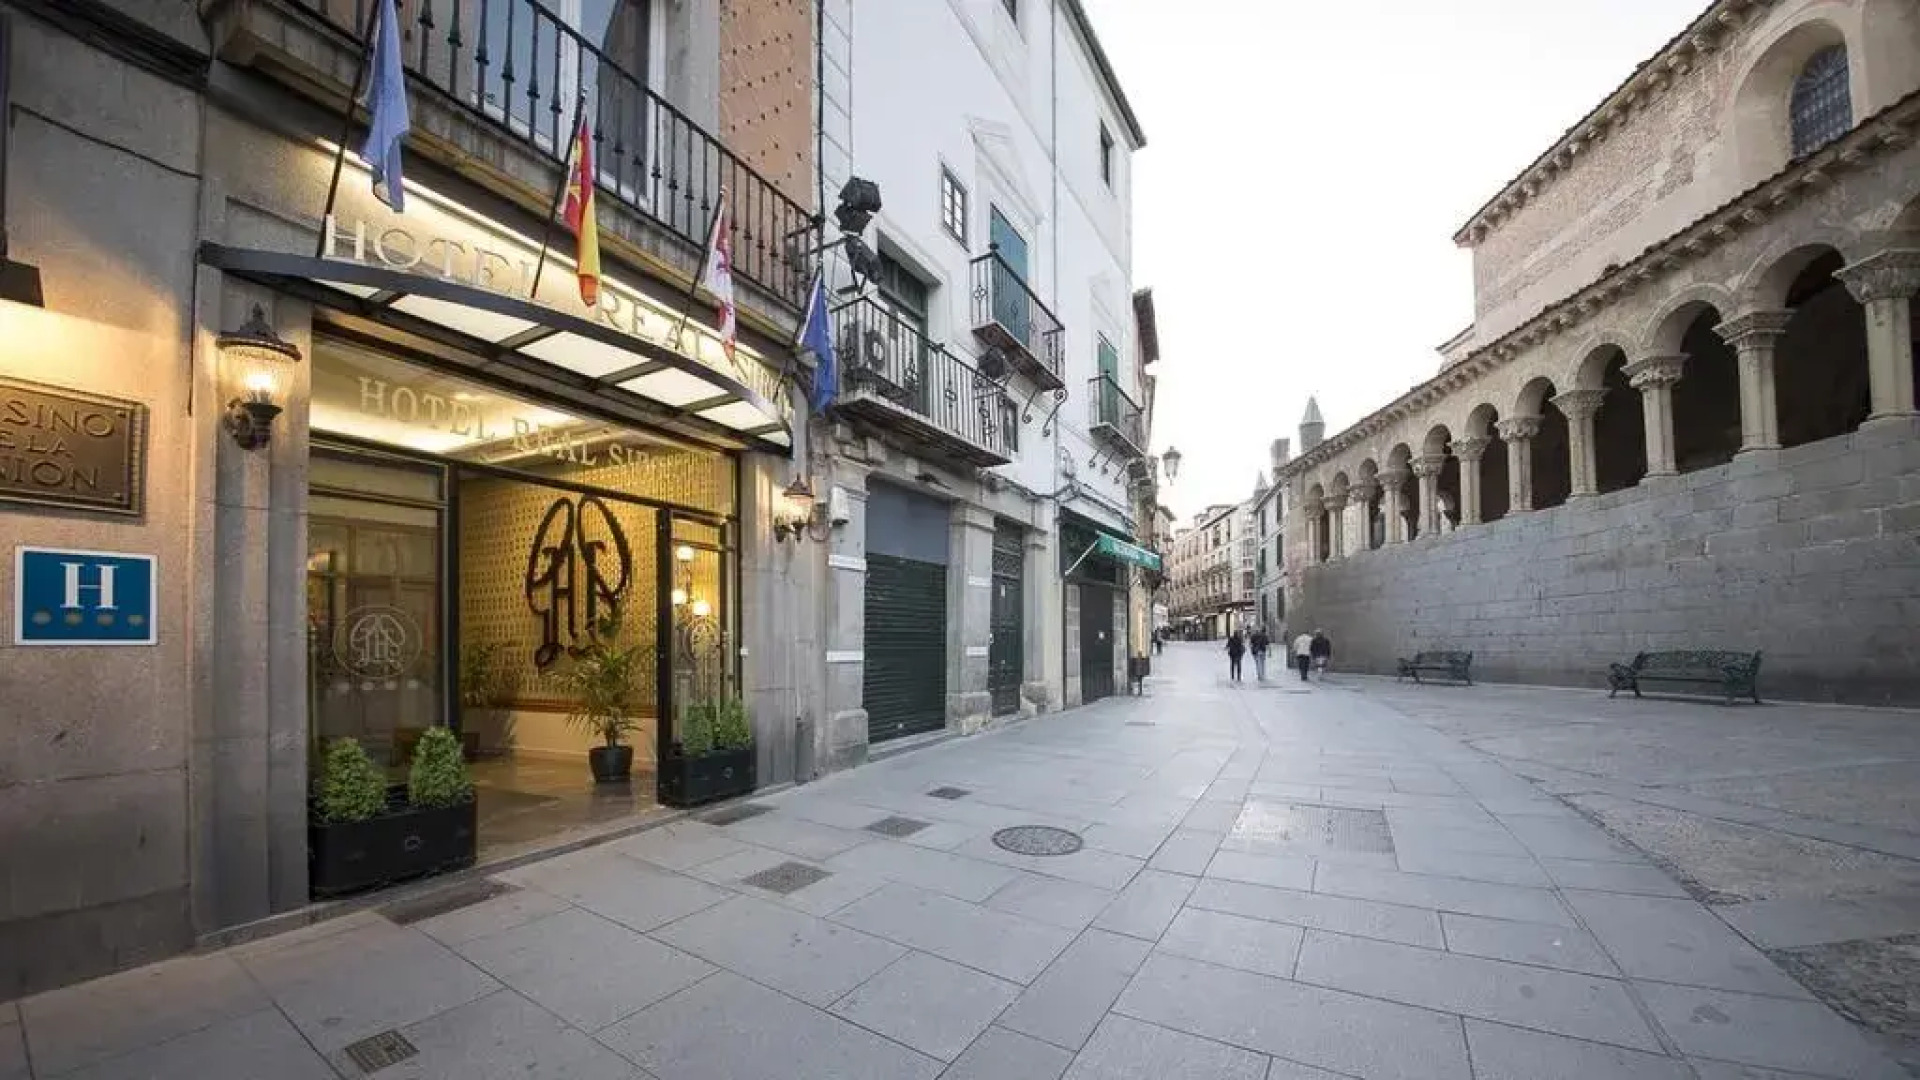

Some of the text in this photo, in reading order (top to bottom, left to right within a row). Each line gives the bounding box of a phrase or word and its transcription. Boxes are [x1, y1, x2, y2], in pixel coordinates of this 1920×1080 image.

[325, 213, 716, 369] HOTEL REAL
[25, 434, 73, 458] LA
[359, 376, 495, 441] HOTEL
[512, 417, 597, 466] REAL
[60, 562, 118, 610] H
